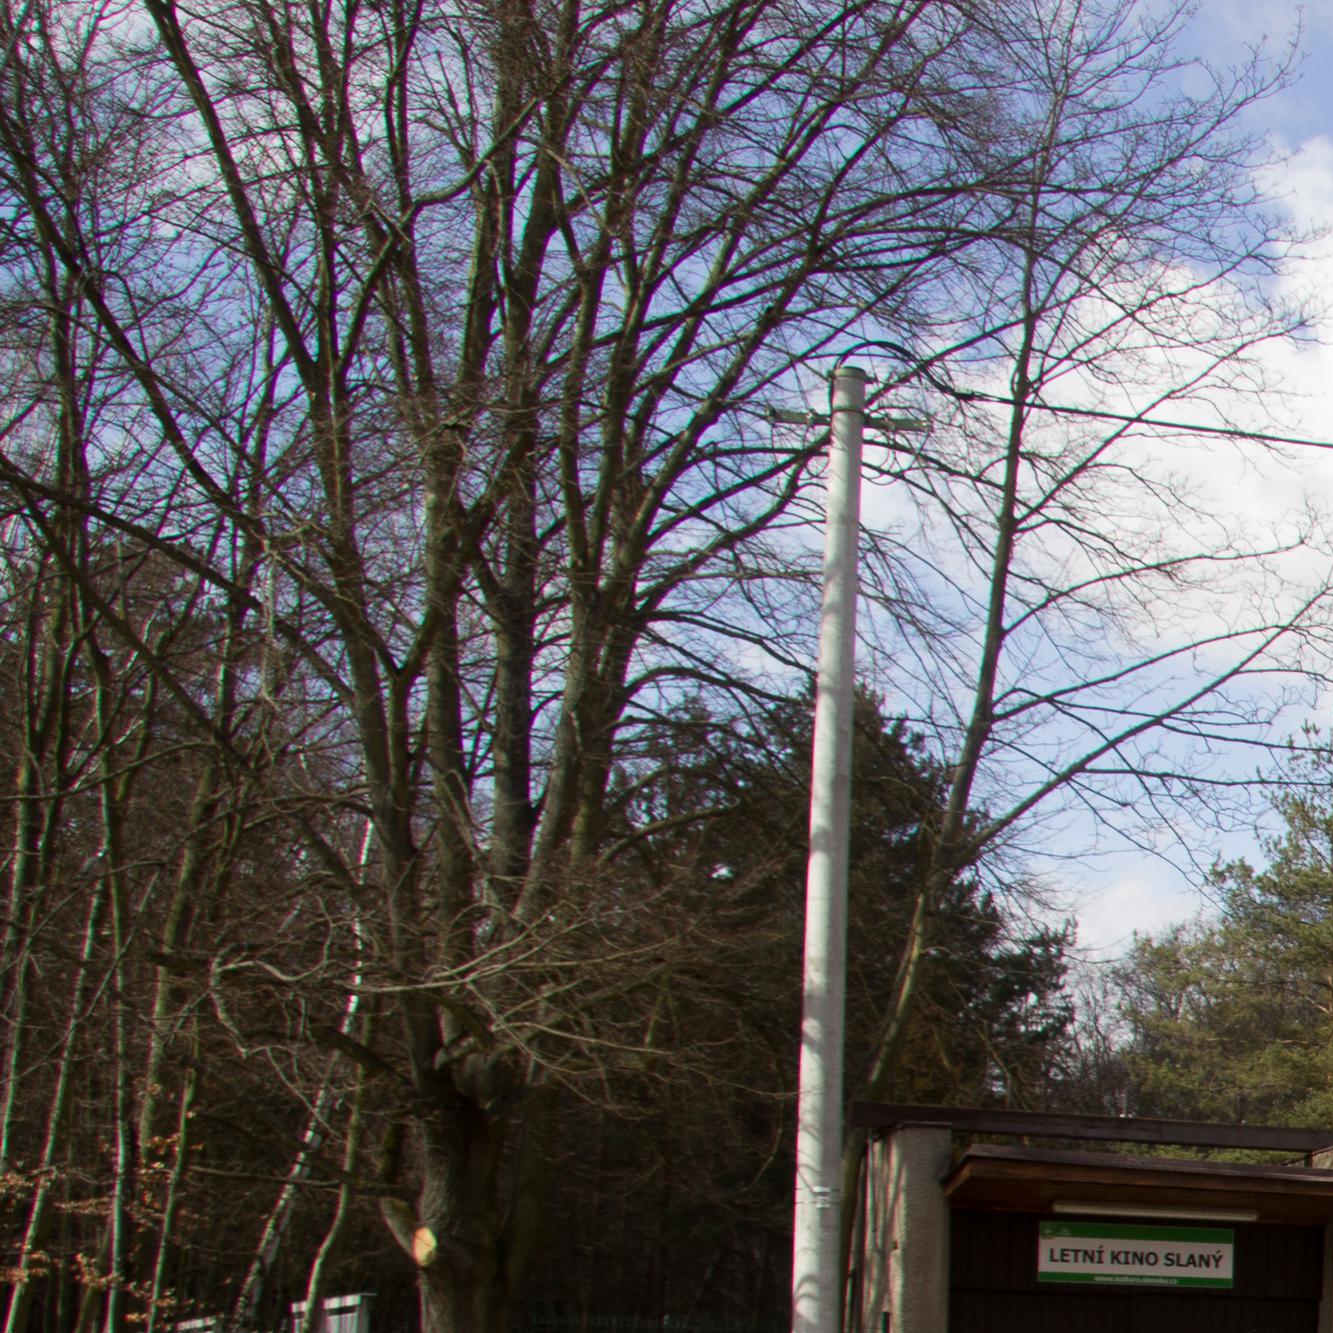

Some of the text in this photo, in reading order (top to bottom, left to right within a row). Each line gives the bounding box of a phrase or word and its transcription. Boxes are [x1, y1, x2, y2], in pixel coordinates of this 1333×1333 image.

[1049, 1245, 1223, 1269] LETNÍ KINO SLANÝ
